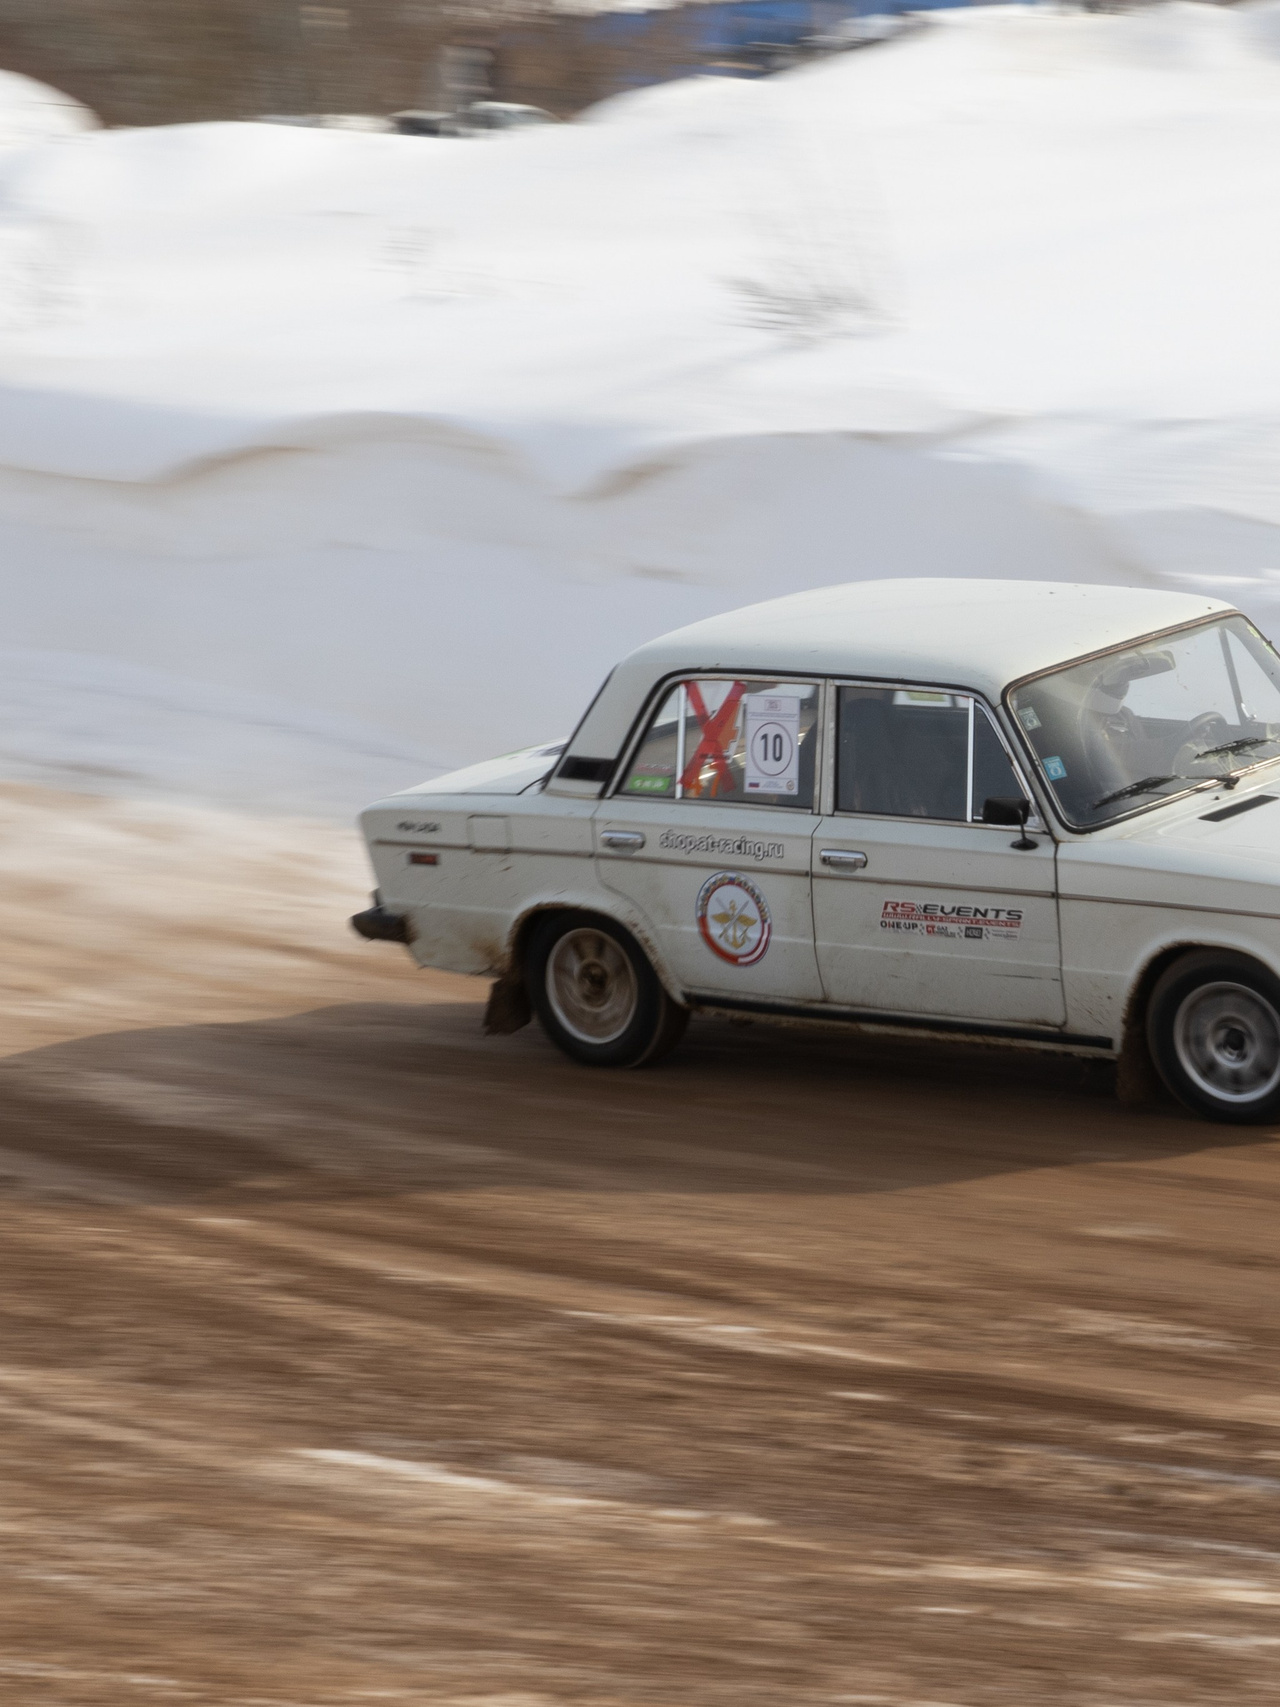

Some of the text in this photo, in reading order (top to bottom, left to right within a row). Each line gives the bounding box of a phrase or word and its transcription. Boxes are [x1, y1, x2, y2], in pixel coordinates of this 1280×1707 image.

[760, 733, 783, 762] 10
[660, 829, 784, 861] shop.at-racing.ru
[883, 900, 1023, 921] RS EVENTS
